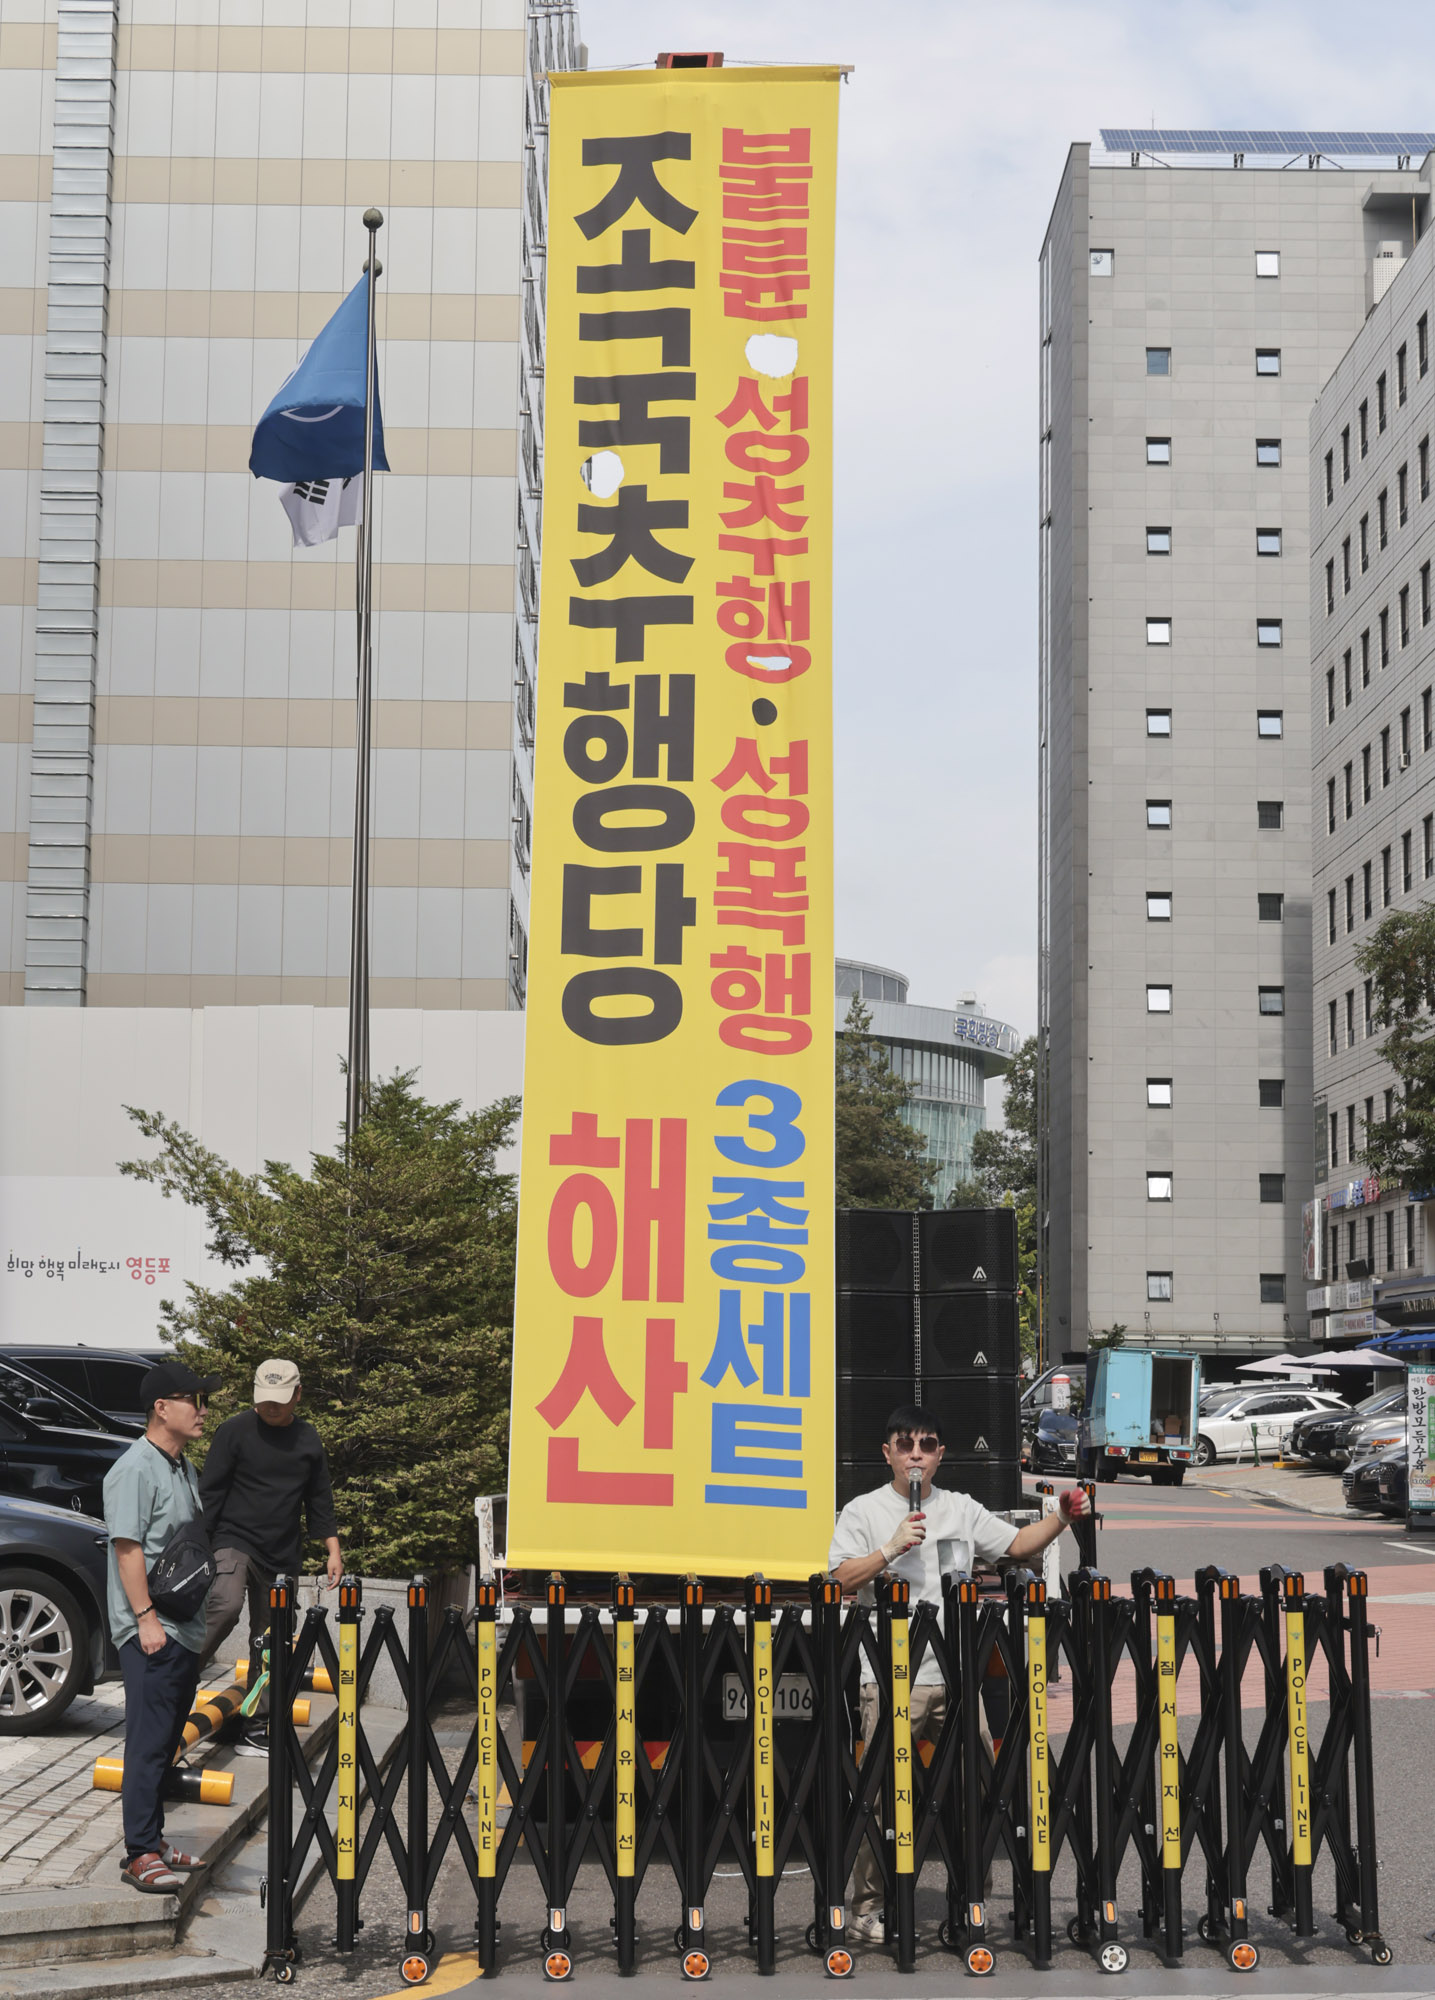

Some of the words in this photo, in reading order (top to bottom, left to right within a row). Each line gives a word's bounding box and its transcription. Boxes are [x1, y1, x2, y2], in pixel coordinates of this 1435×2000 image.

[719, 127, 813, 322] 불륜
[561, 131, 699, 1046] 조국추행당
[955, 1016, 998, 1048] 국회방송
[7, 1249, 34, 1278] 희망
[38, 1255, 65, 1281] 행복
[126, 1257, 170, 1285] 영등포
[535, 1111, 689, 1506] 해산
[700, 1079, 811, 1509] 3종세트
[480, 1668, 493, 1766] POLICE
[757, 1667, 770, 1765] POLICE
[893, 1664, 912, 1847] 질서유지선
[1033, 1663, 1046, 1760] POLICE
[1160, 1660, 1180, 1842] 질서유지선
[1291, 1658, 1305, 1755] POLICE
[338, 1667, 354, 1853] 질서유지선
[618, 1667, 634, 1850] 질서유지선
[1297, 1774, 1308, 1838] LINE
[481, 1785, 492, 1850] LINE
[761, 1784, 771, 1849] LINE
[1037, 1780, 1047, 1844] LINE
